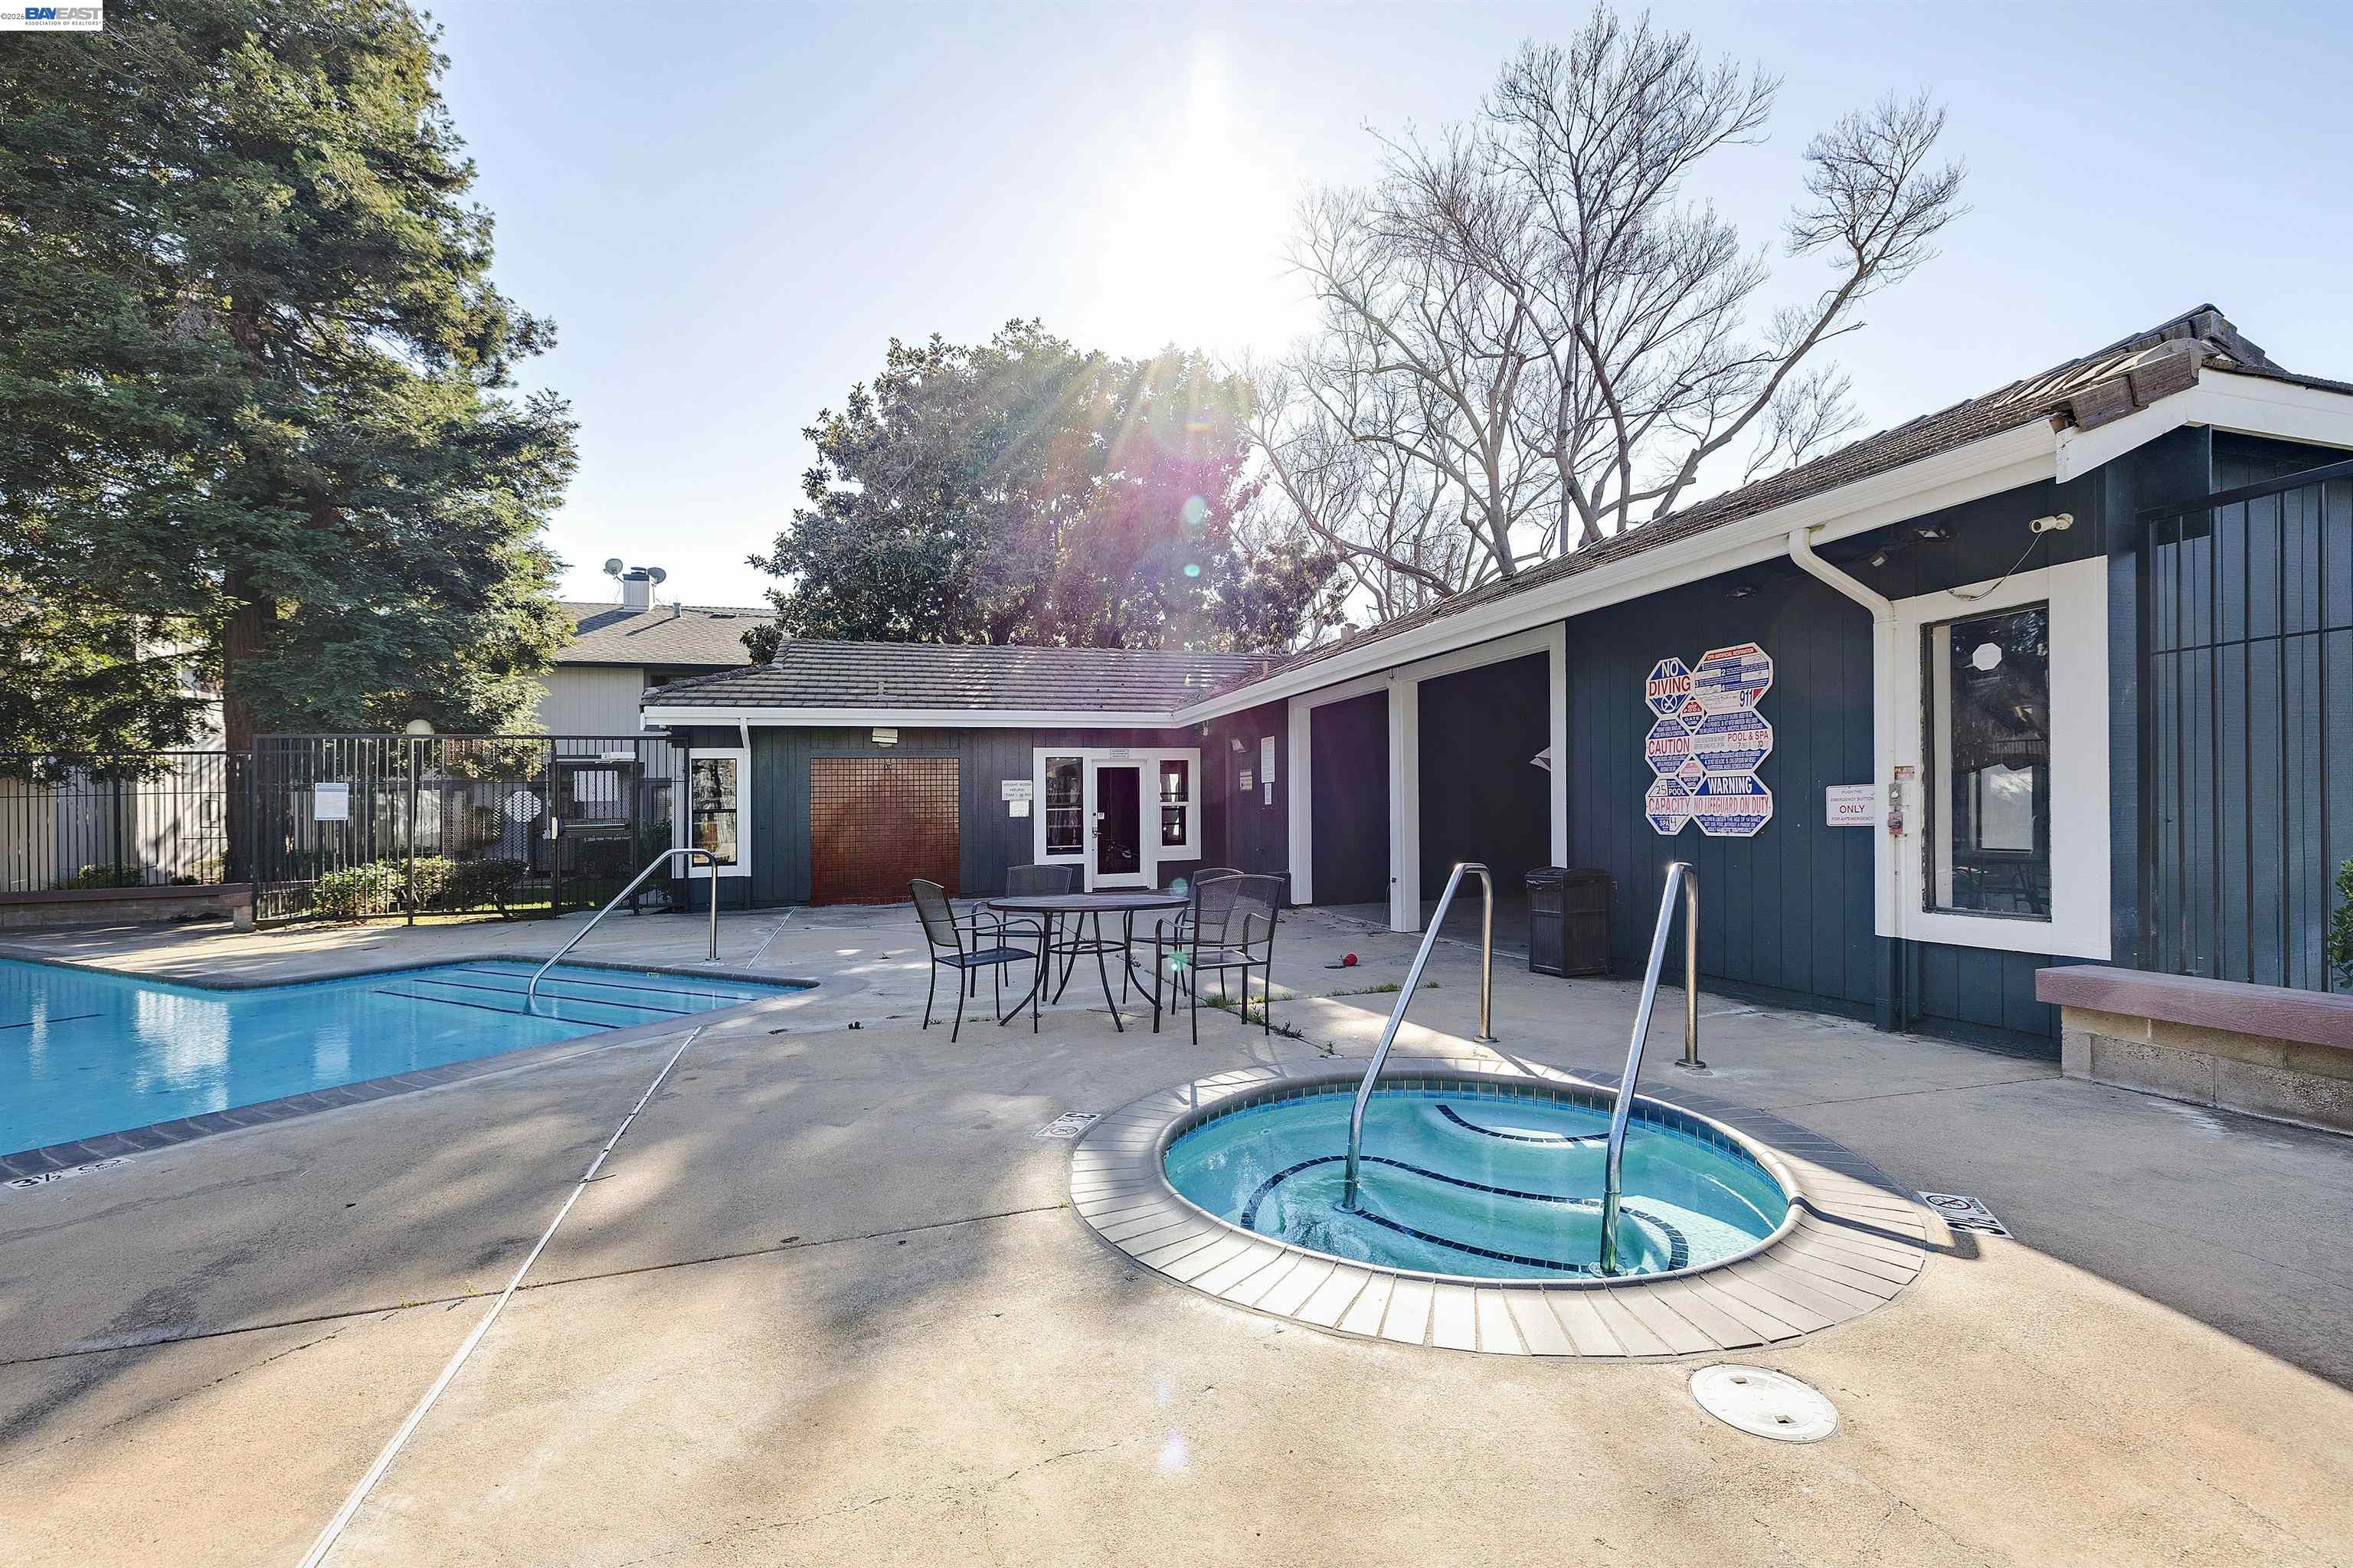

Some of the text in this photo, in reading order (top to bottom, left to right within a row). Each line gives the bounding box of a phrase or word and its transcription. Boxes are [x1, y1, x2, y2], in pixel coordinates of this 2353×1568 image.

[1661, 660, 1679, 677] NO
[1649, 675, 1691, 696] DIVING
[1739, 689, 1752, 707] 911
[1727, 732, 1747, 741] POOL
[1749, 732, 1753, 741] &
[1755, 730, 1769, 740] SPA
[1648, 738, 1690, 755] CAUTION
[1656, 784, 1667, 795] 25
[1707, 777, 1753, 794] WARNING
[1648, 797, 1690, 813] CAPACITY
[1694, 797, 1769, 813] NO LIFEGUARD ON DUTY
[1839, 804, 1865, 813] ONLY
